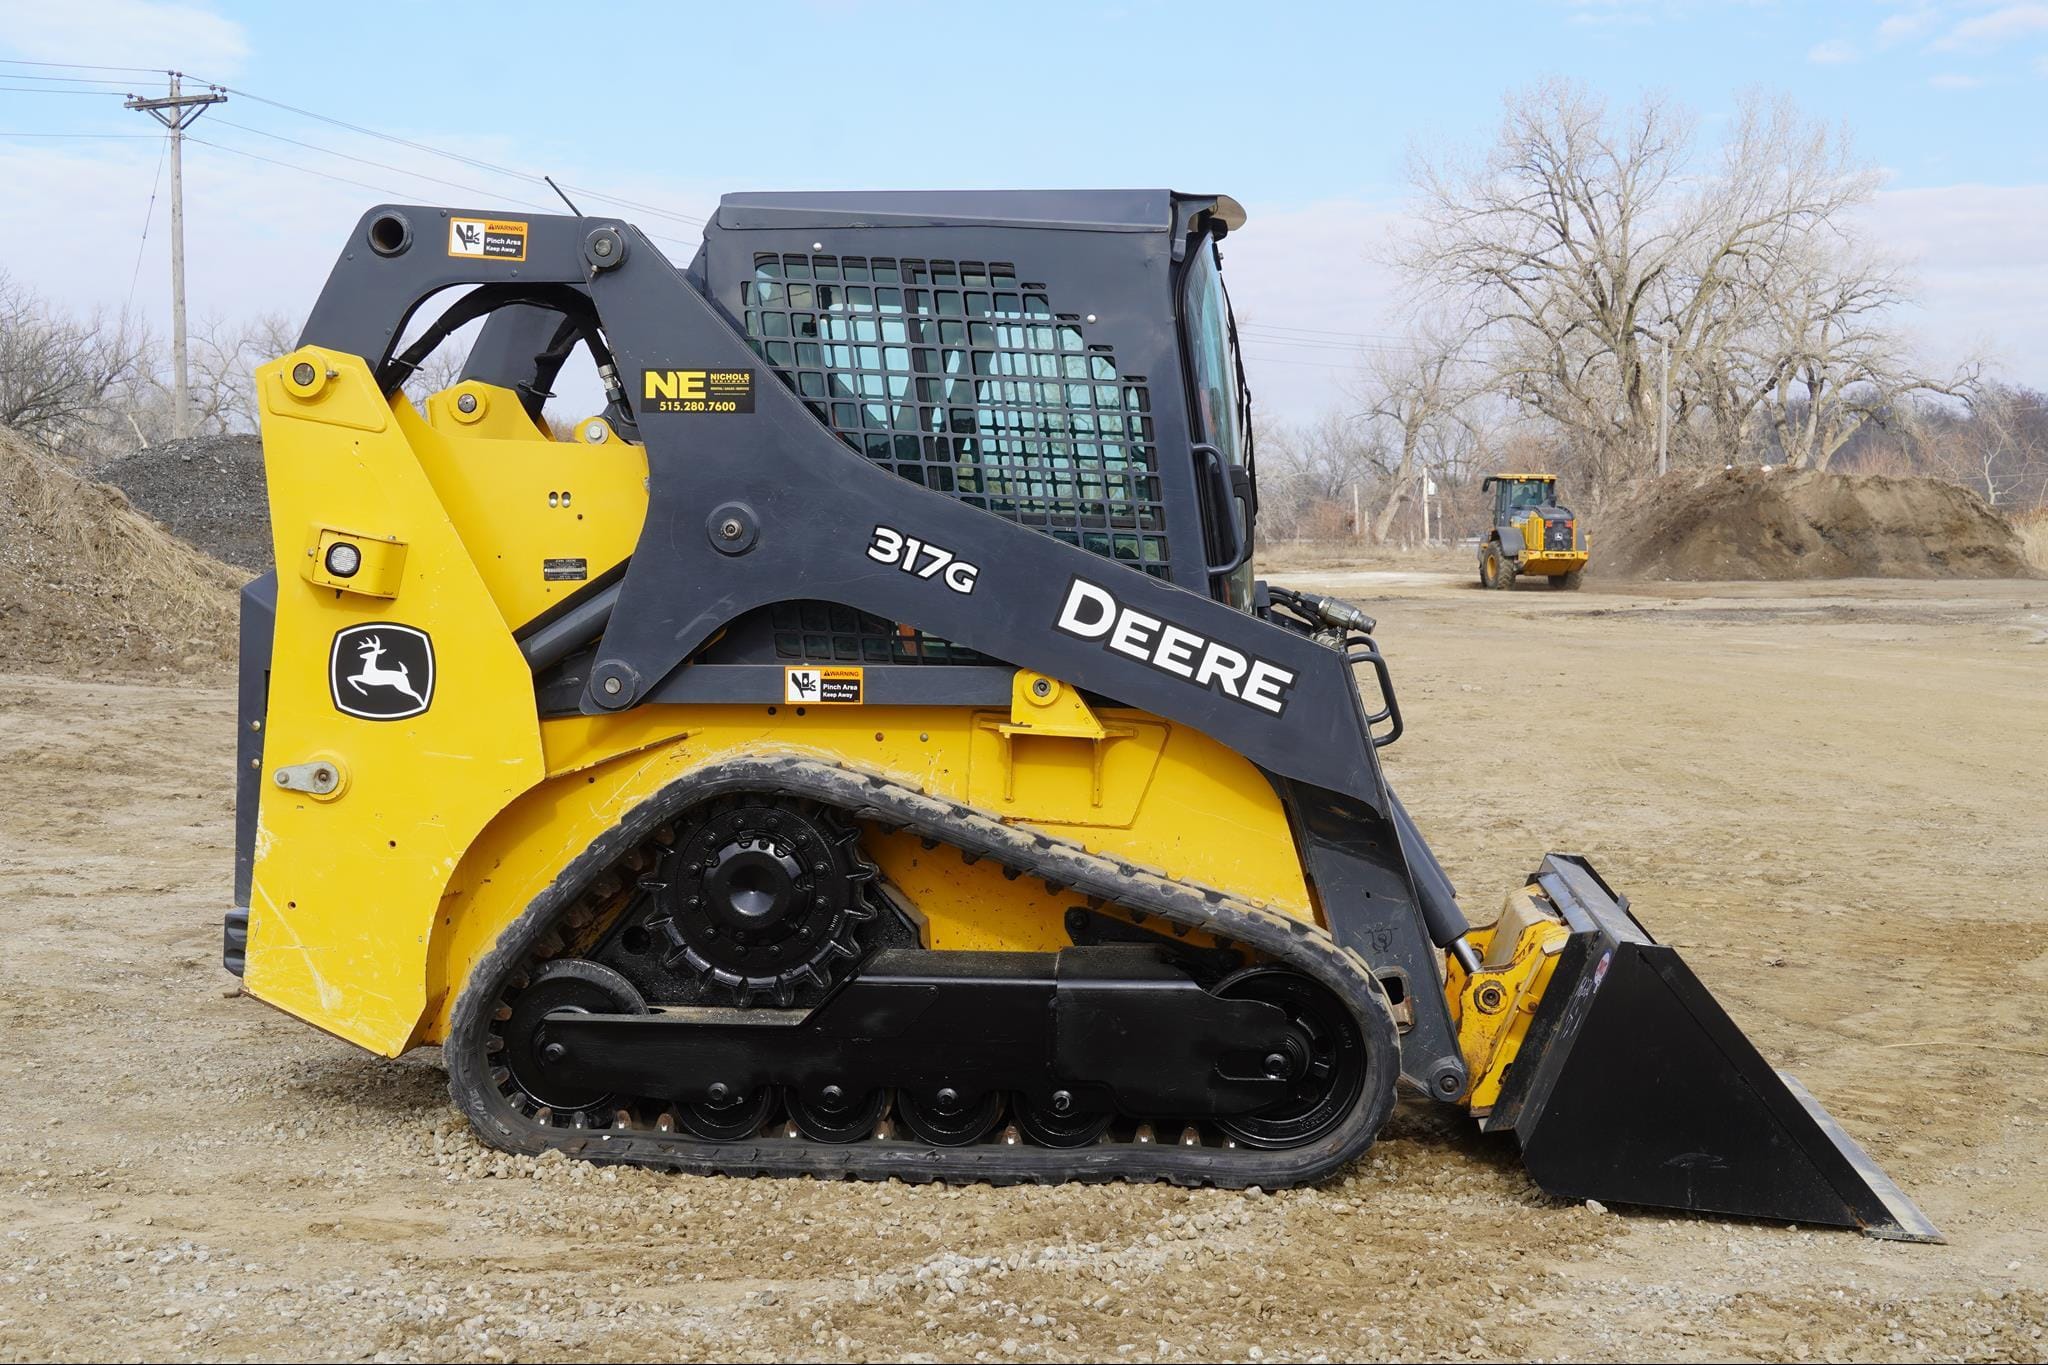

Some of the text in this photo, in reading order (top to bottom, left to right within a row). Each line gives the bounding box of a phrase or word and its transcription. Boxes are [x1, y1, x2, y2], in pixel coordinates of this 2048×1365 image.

[494, 224, 523, 232] WARNING
[486, 237, 521, 246] Pinch Area
[501, 246, 516, 254] Away
[645, 371, 706, 399] NE
[659, 401, 736, 411] 515.280.7600
[867, 527, 979, 594] 317G
[1058, 578, 1294, 713] DEERE
